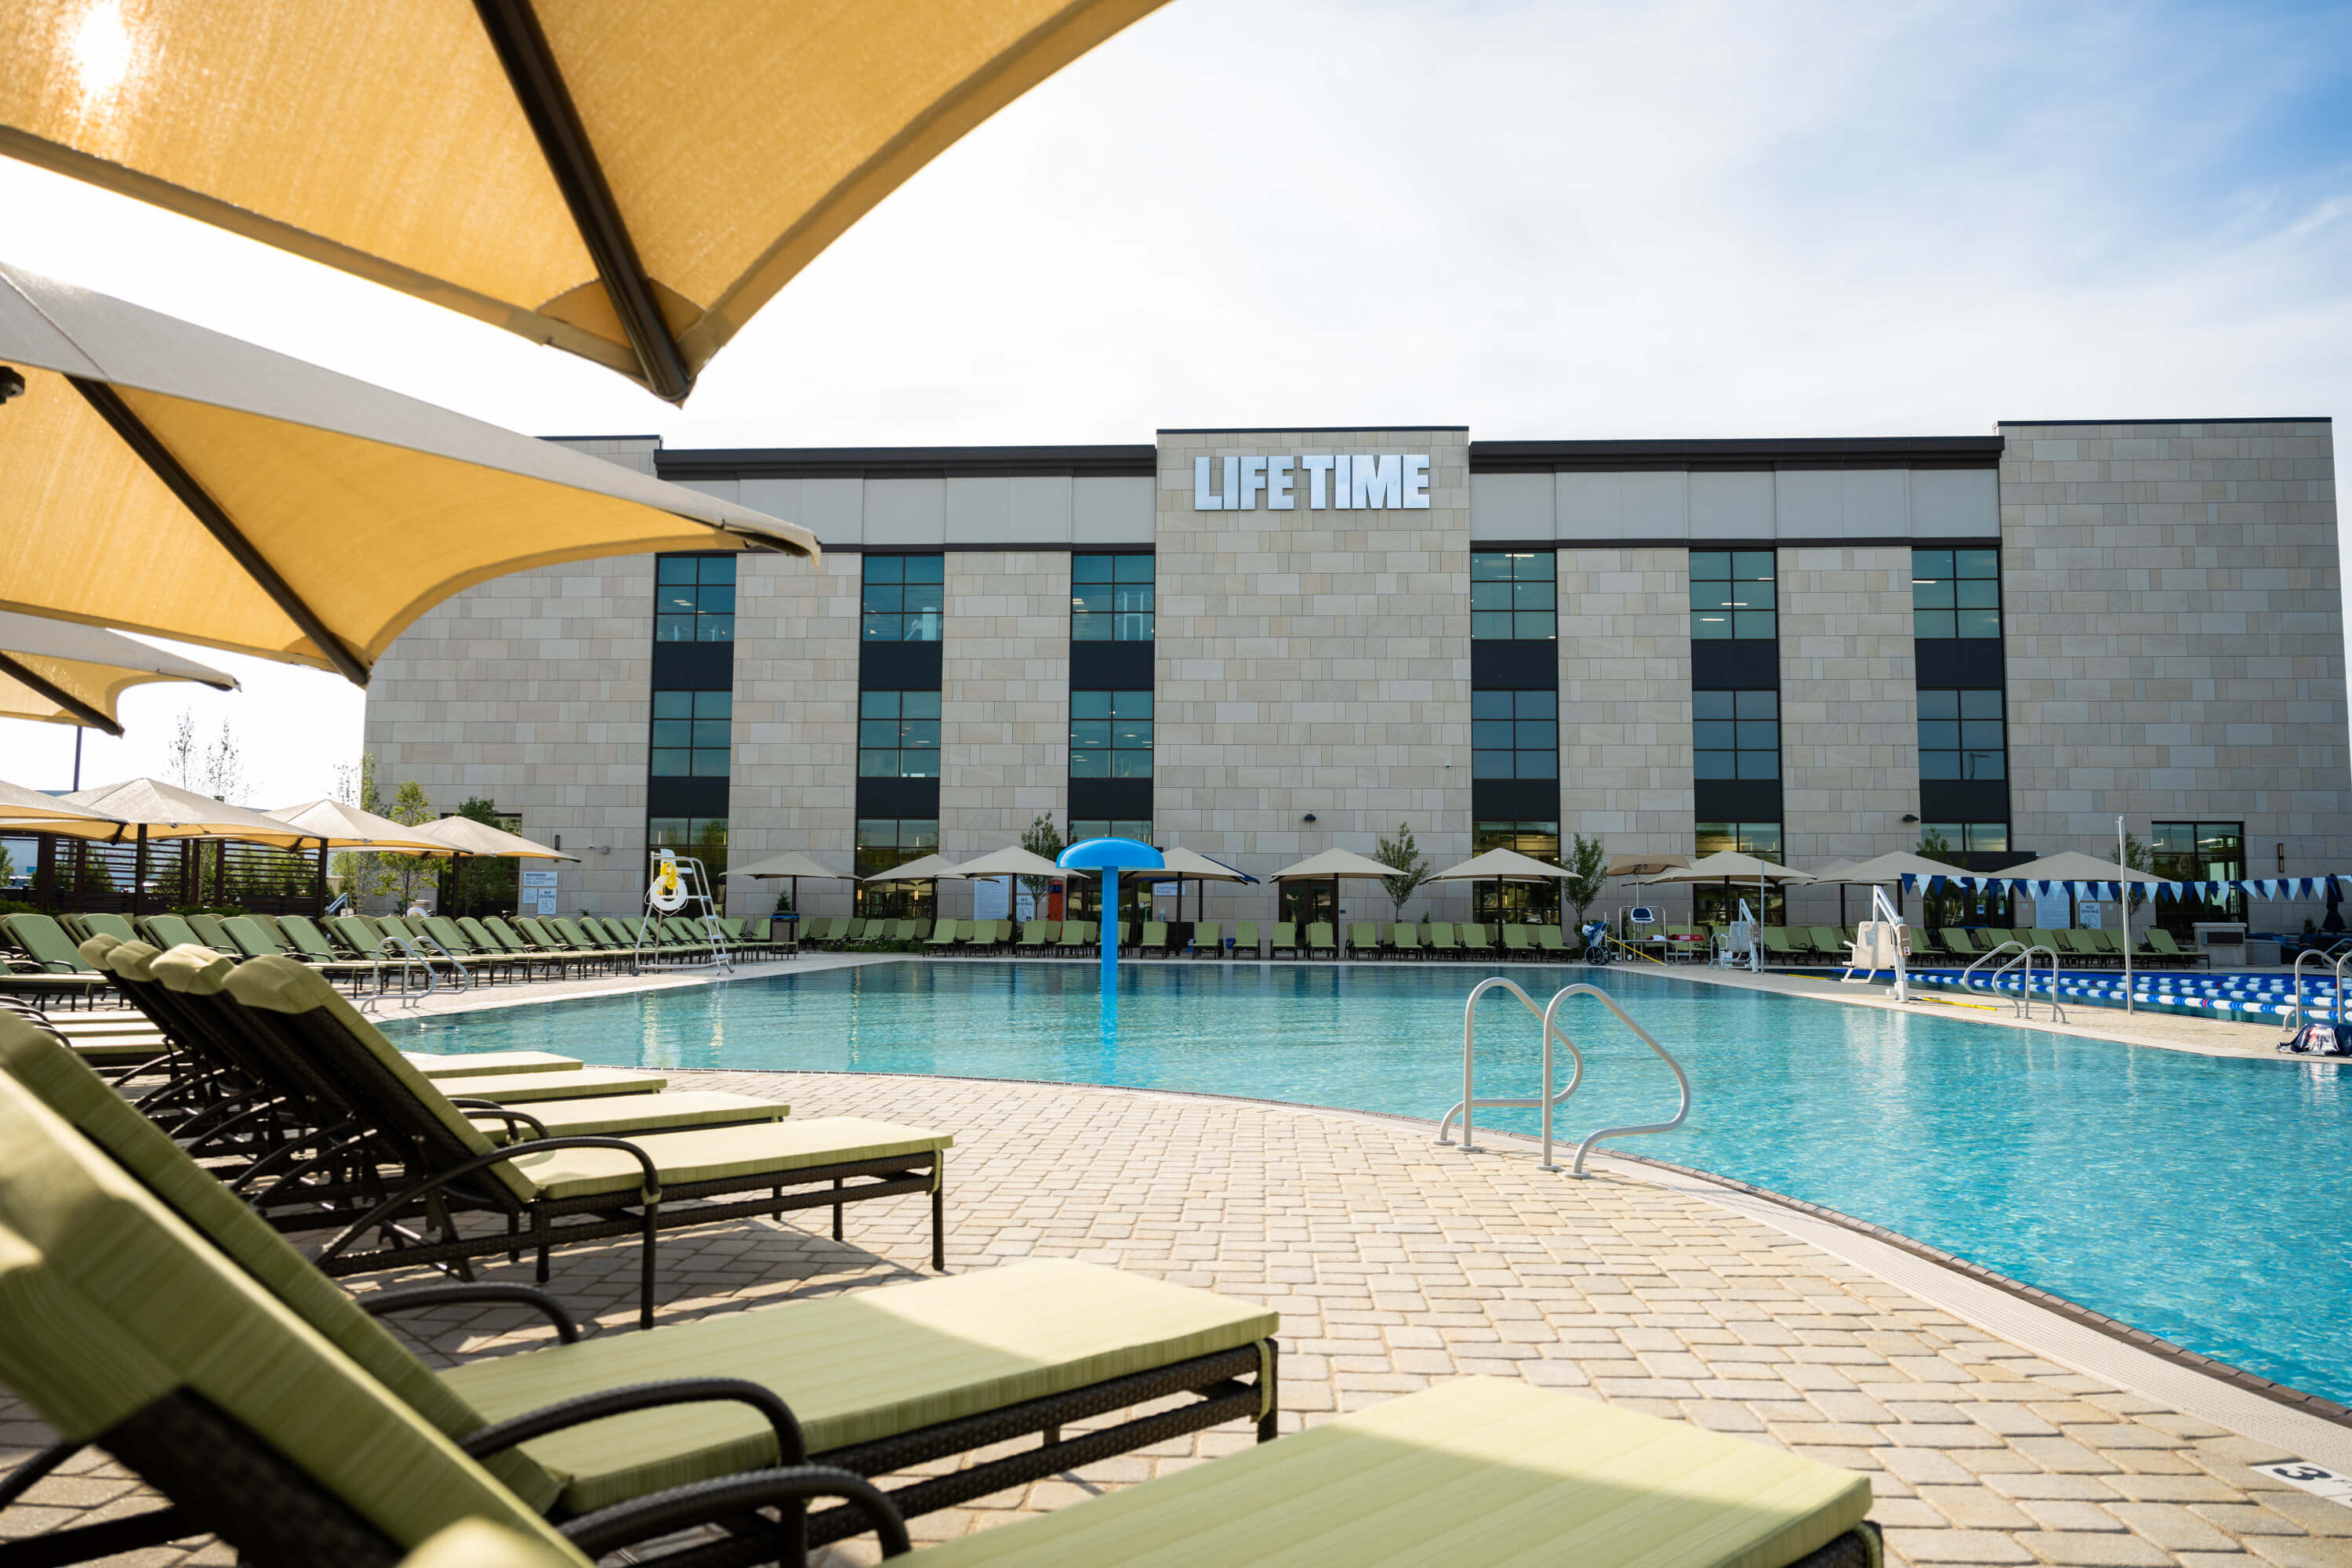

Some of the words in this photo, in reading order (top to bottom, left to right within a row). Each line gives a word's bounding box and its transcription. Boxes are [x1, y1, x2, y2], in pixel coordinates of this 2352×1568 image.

[1194, 456, 1294, 510] LIFE
[1302, 454, 1430, 510] TIME
[2272, 1466, 2332, 1481] 3
